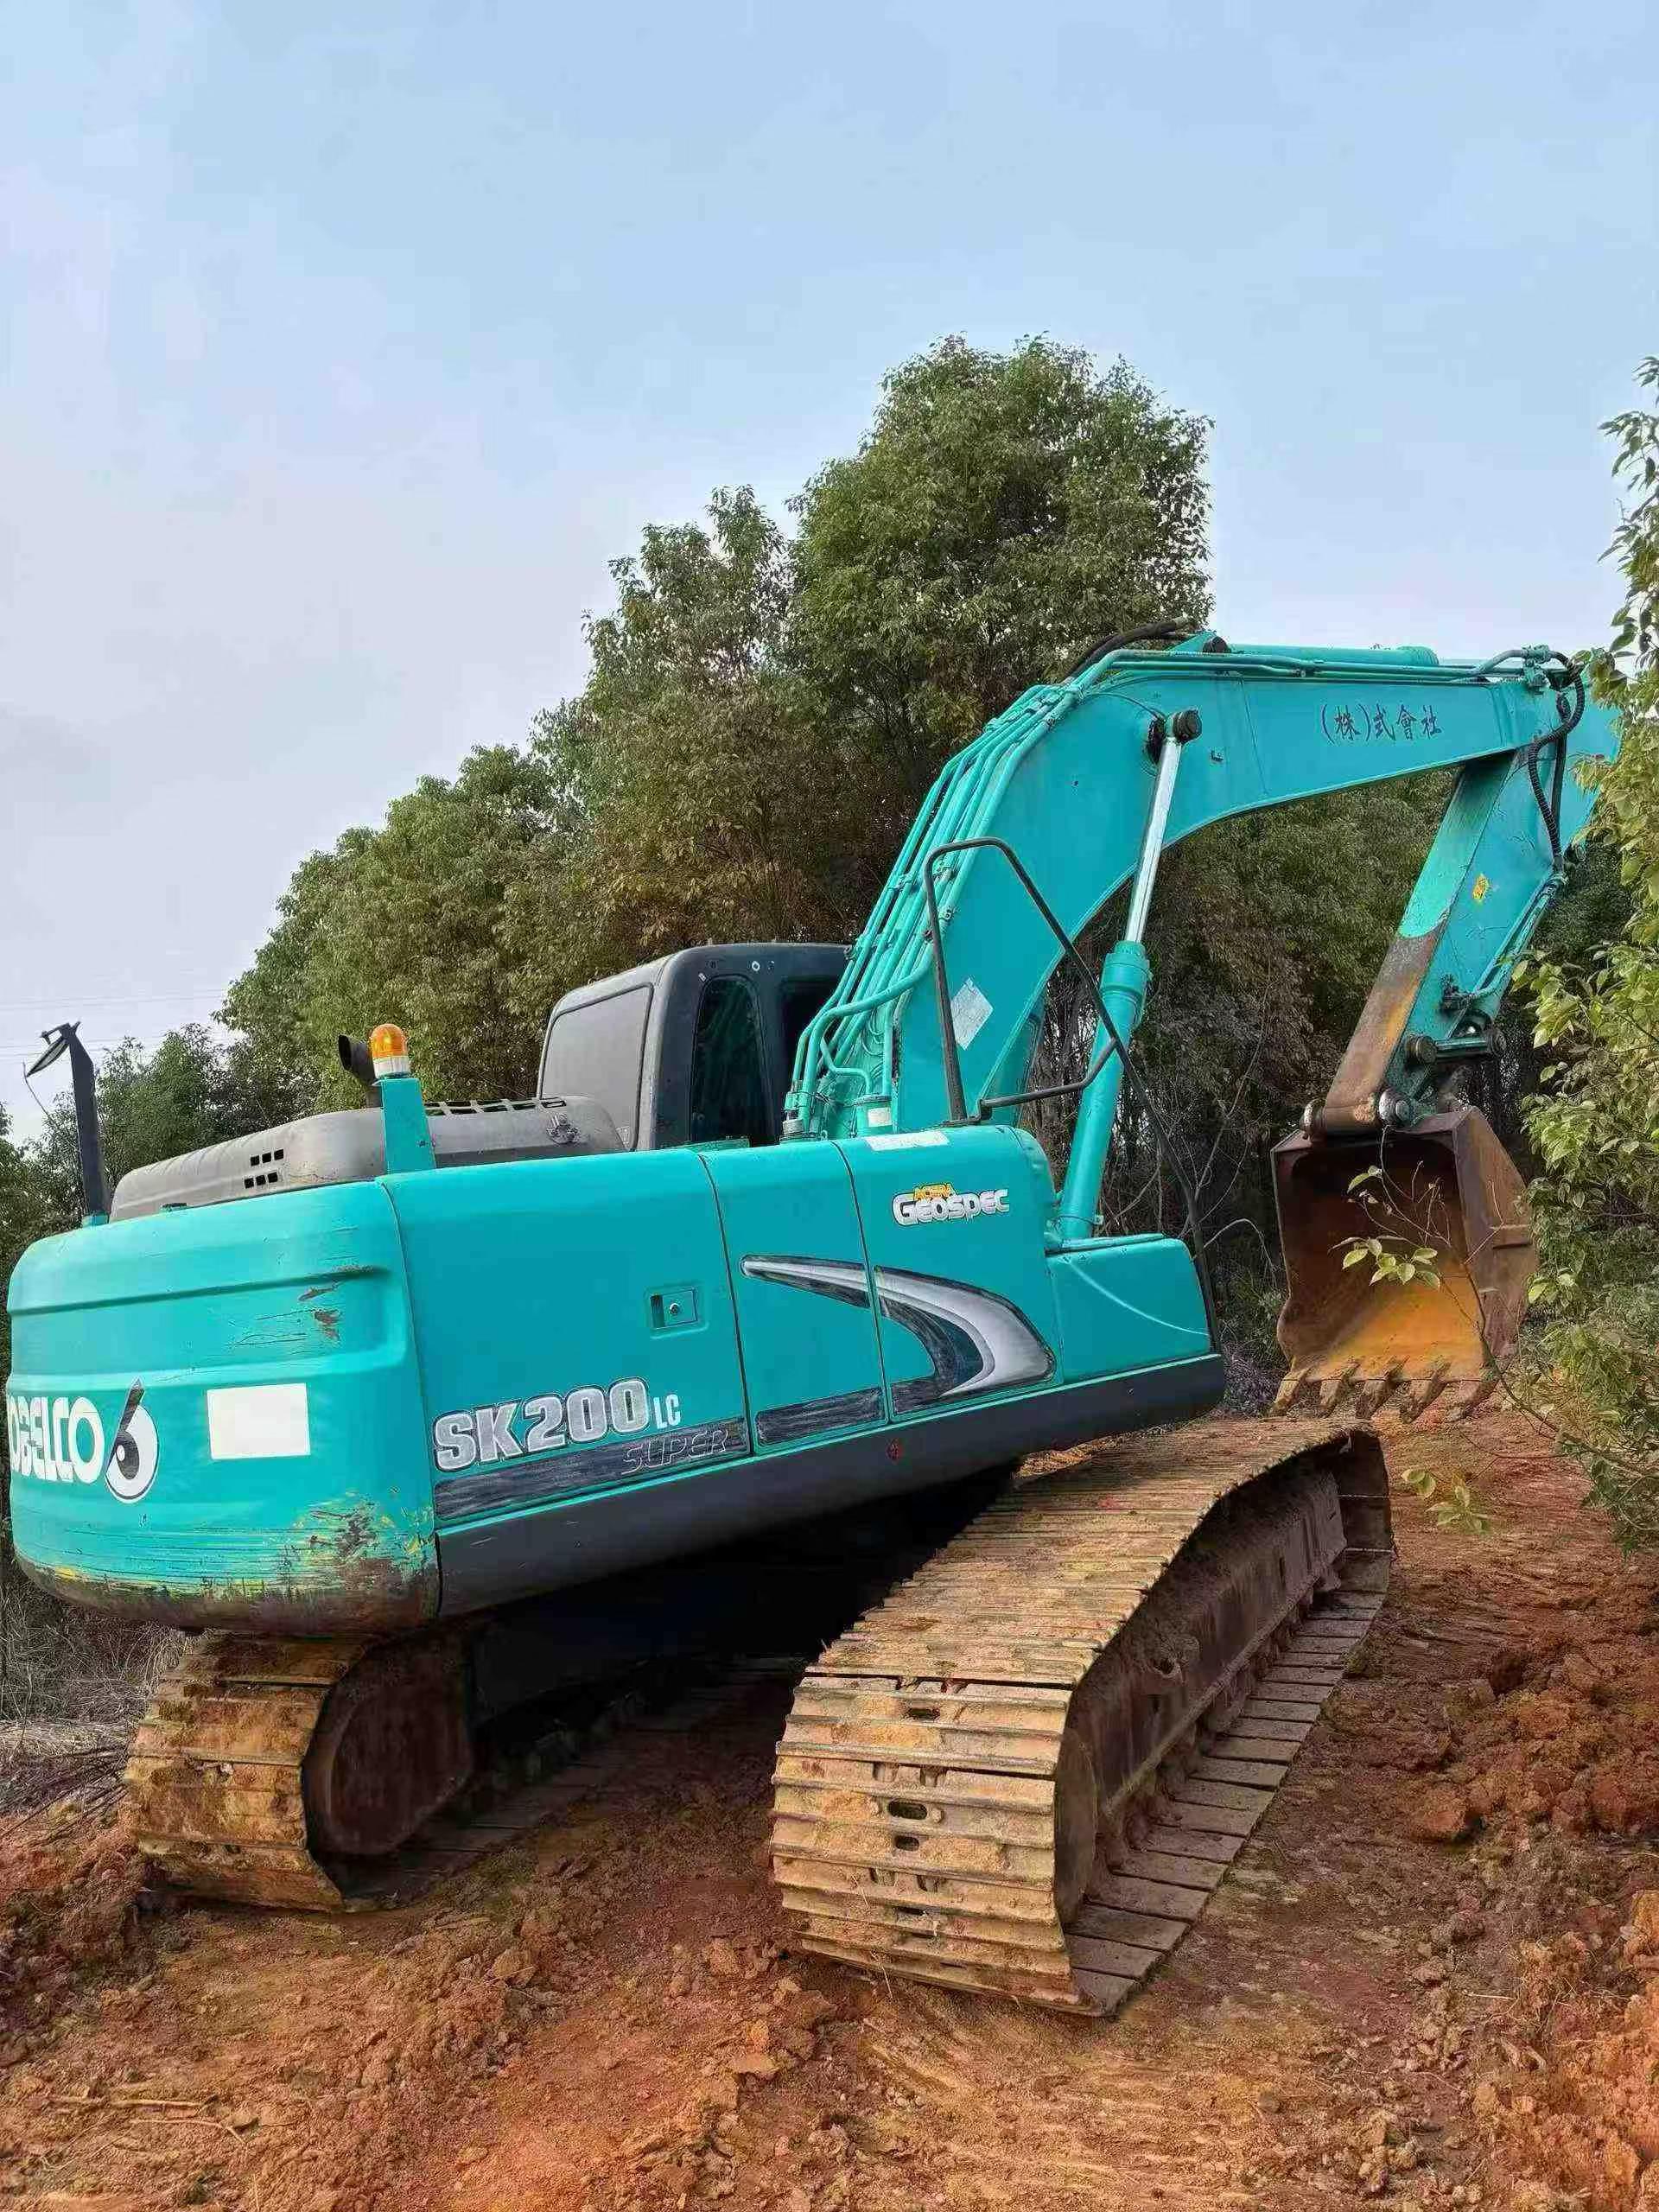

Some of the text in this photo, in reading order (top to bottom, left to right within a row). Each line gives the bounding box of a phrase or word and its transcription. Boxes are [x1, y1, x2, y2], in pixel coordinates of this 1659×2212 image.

[7, 1395, 105, 1484] OBELCO
[434, 1377, 682, 1471] SK200 LC
[621, 1429, 729, 1475] SUPER
